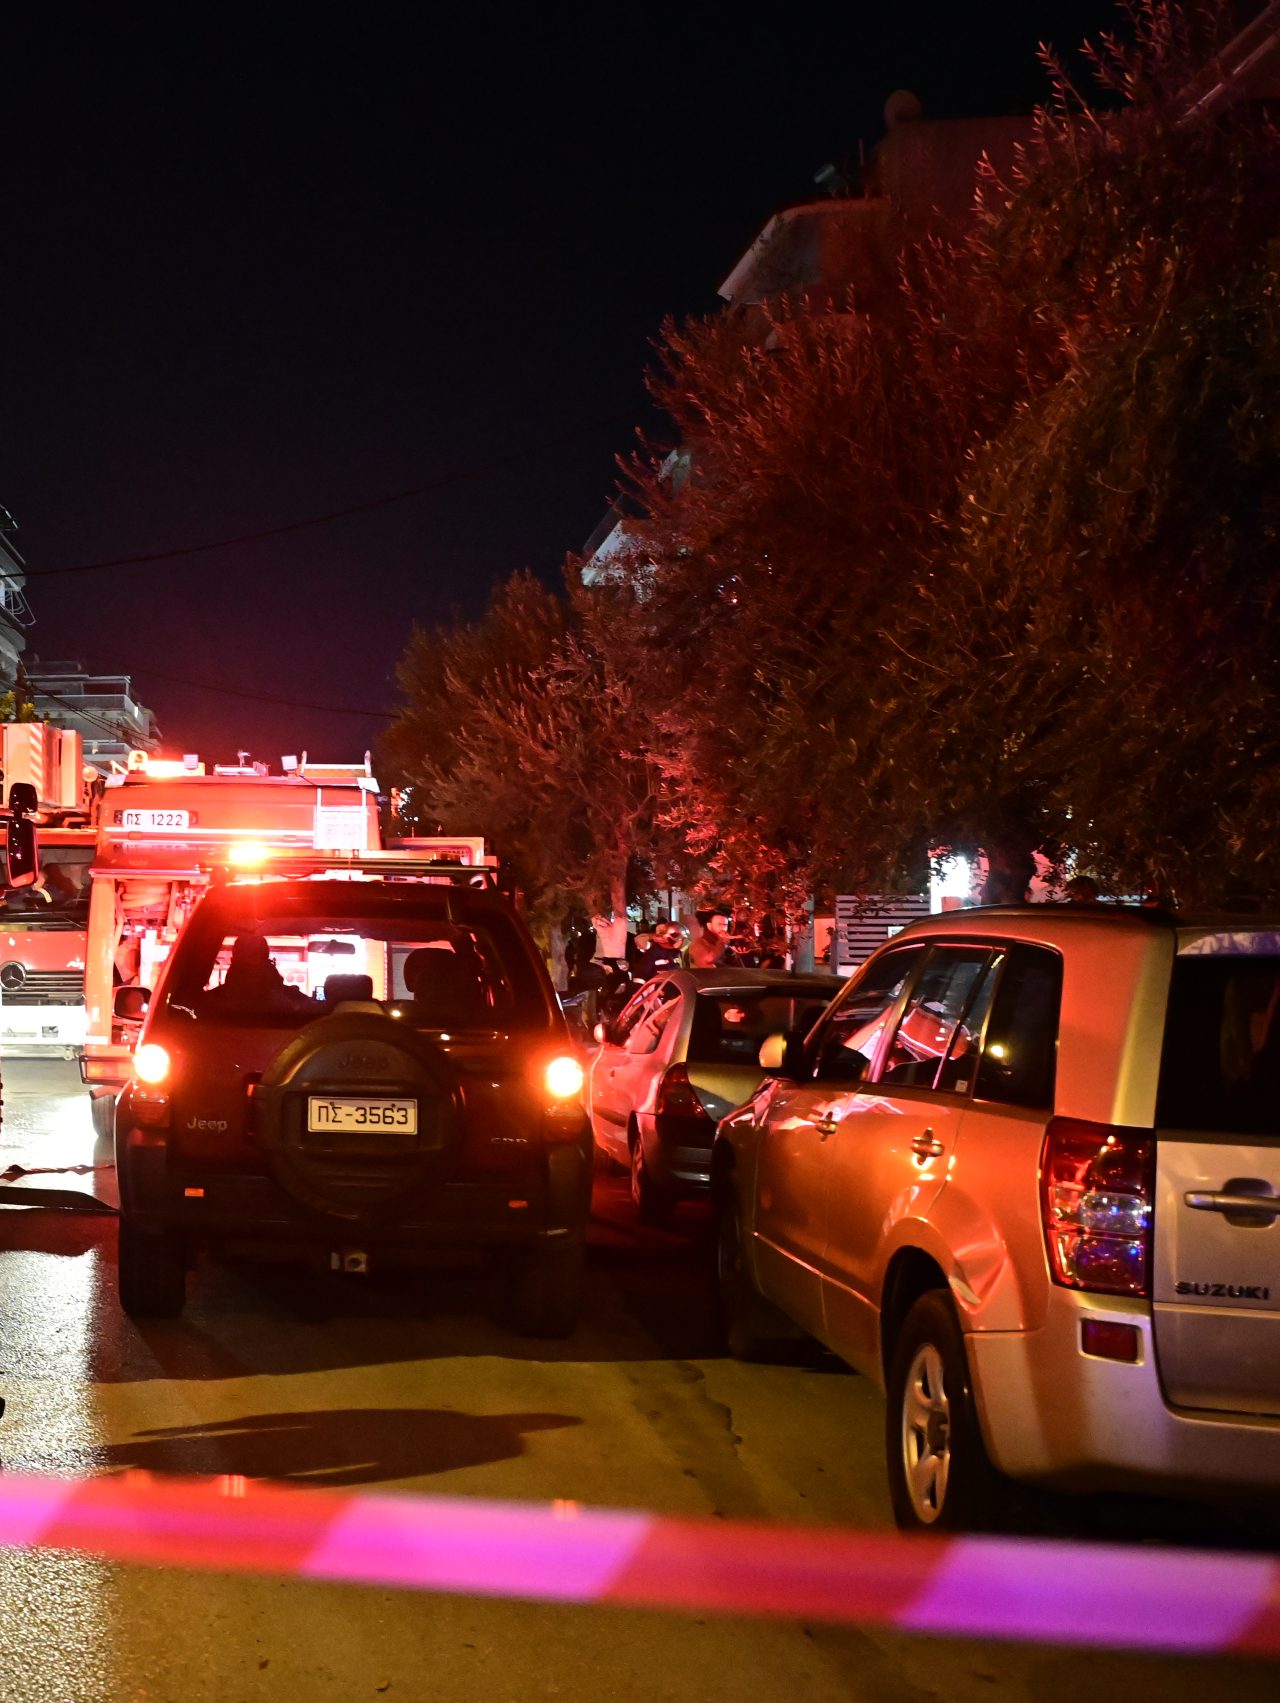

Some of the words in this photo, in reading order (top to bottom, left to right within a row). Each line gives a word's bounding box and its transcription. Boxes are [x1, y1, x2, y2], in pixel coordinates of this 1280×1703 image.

[126, 813, 141, 826] ΠΣ
[151, 813, 183, 826] 1222
[187, 1115, 227, 1134] Jeep
[317, 1105, 408, 1125] ΠΣ-3563
[1175, 1281, 1269, 1300] SUZUKI
